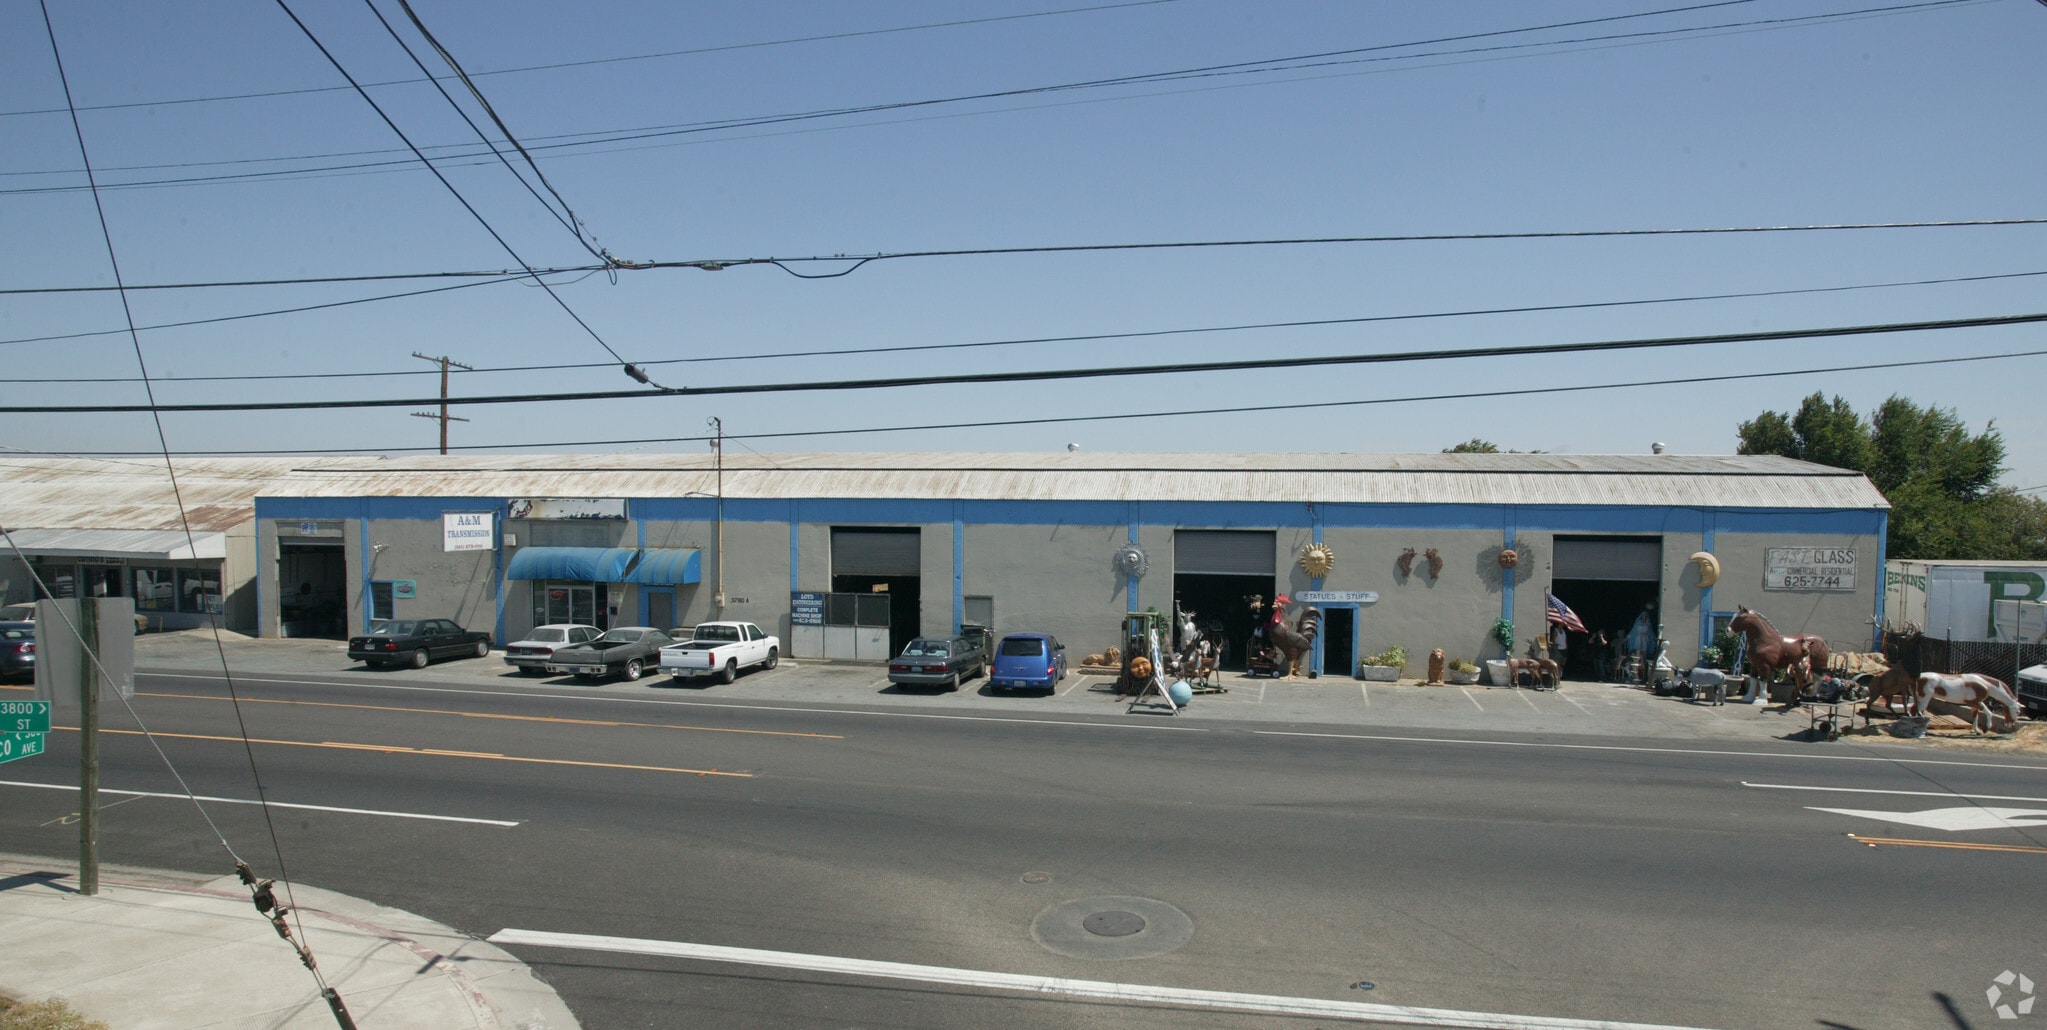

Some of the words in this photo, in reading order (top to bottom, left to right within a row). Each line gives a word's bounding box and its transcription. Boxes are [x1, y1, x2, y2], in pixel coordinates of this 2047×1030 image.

[457, 515, 481, 526] A&M
[447, 530, 490, 538] TRANSMISSION
[1814, 550, 1854, 564] GLASS
[1786, 567, 1818, 576] COMMERCIAL
[1821, 567, 1854, 576] RESIDENTIAL
[1784, 576, 1840, 587] 625-7744
[1887, 571, 1926, 593] BEKINS
[1, 703, 33, 714] 3800
[17, 719, 31, 730] ST
[22, 741, 37, 755] AVE
